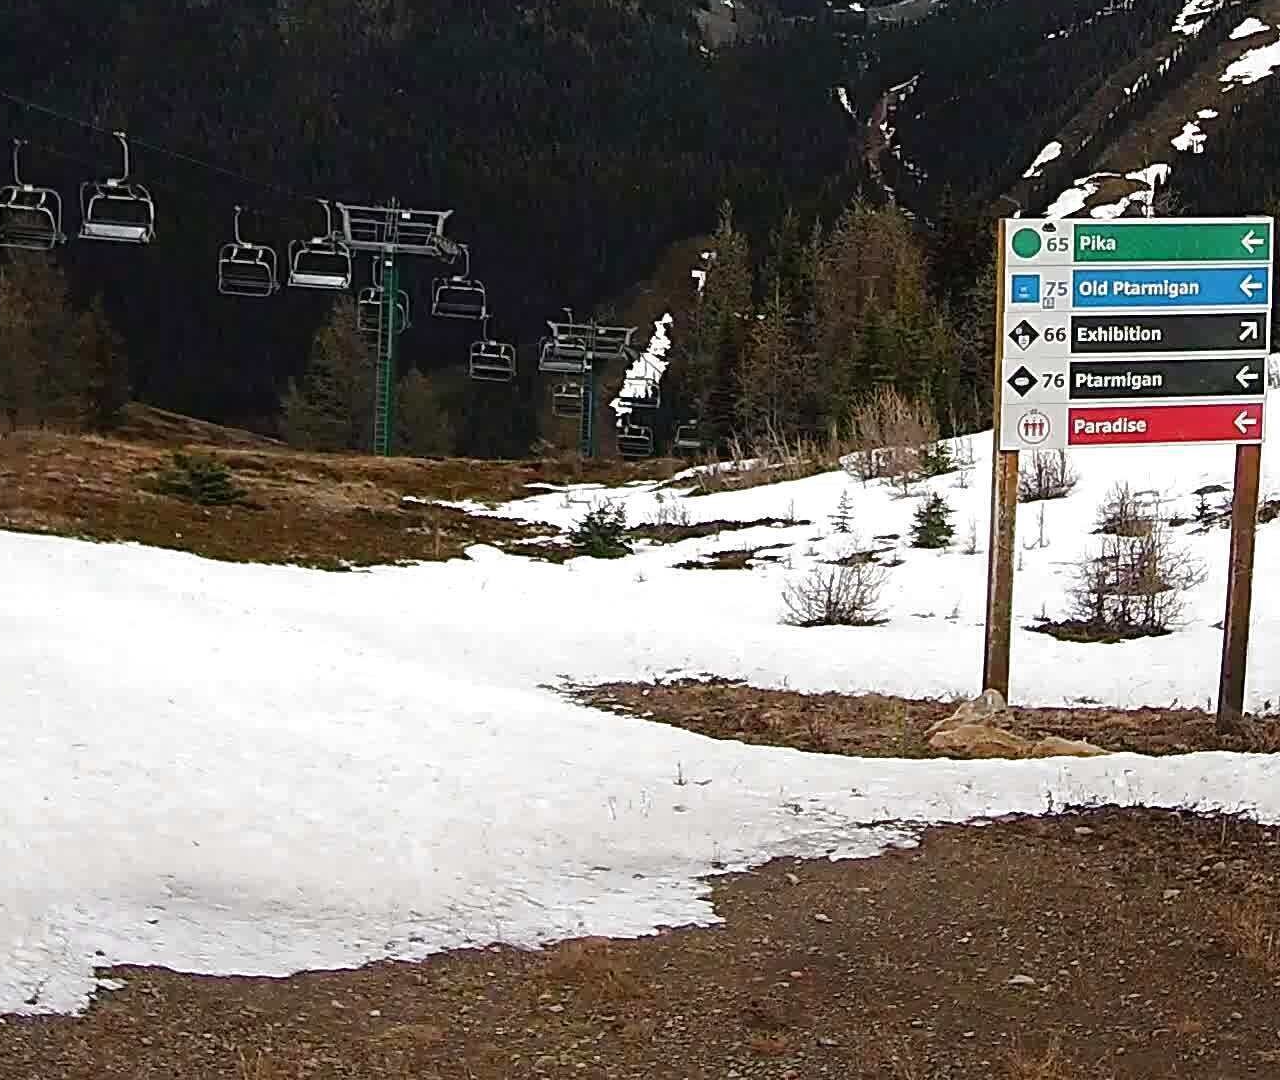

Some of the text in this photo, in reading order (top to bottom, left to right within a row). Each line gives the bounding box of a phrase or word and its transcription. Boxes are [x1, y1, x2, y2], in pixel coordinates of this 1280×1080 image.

[1046, 232, 1116, 253] 65 Pika
[1045, 281, 1200, 299] 75 Old Ptarmigan
[1044, 326, 1162, 343] 66 Exhibition
[1042, 371, 1163, 390] 76 Ptarmigan
[1074, 417, 1147, 434] Paradise
